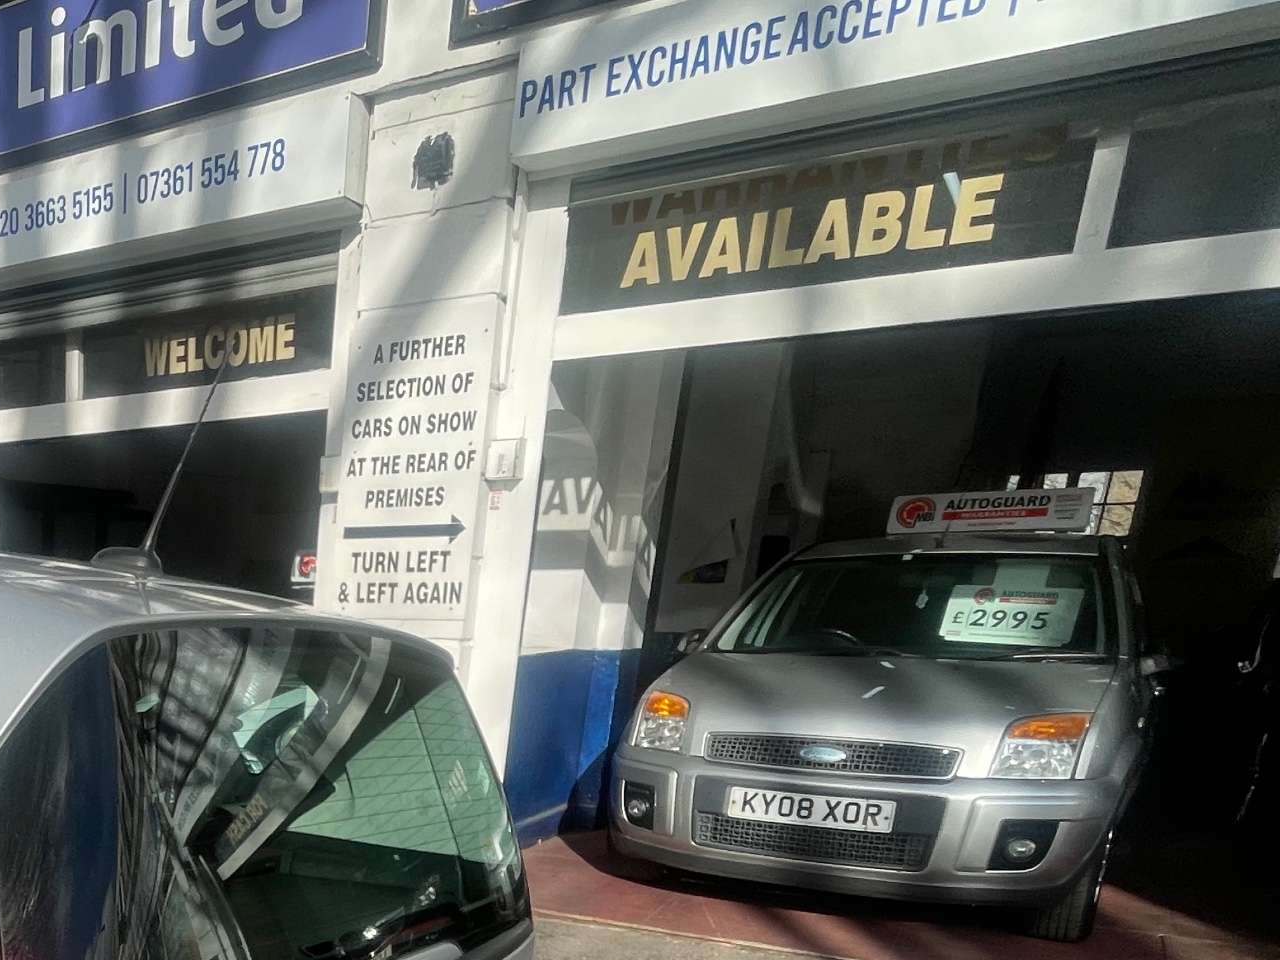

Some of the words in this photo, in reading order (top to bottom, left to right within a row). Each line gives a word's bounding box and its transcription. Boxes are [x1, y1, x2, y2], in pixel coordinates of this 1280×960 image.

[519, 63, 598, 118] PART
[606, 16, 786, 97] EXCHANGE
[25, 195, 66, 231] 3663
[73, 183, 113, 219] 5155
[137, 162, 193, 204] 07361
[201, 150, 239, 189] 554
[247, 138, 286, 177] 778
[620, 173, 1005, 289] AVAILABLE
[144, 314, 296, 377] WELCOME
[374, 345, 384, 364] A
[389, 334, 466, 362] FURTHER
[357, 375, 447, 402] SELECTION
[451, 372, 474, 394] OF
[351, 416, 393, 440] CARS
[398, 414, 421, 435] ON
[426, 410, 477, 434] SHOW
[347, 456, 368, 478] AT
[371, 454, 400, 475] THE
[406, 452, 449, 474] REAR
[453, 449, 476, 471] OF
[365, 486, 445, 510] PREMISES
[945, 494, 1051, 511] AUTOGUARD
[352, 551, 401, 574] TURN
[406, 550, 451, 573] LEFT
[338, 582, 349, 603] &
[356, 582, 398, 605] LEFT
[403, 581, 462, 605] AGAIN
[741, 791, 814, 820] KY08
[821, 799, 882, 827] XOR
